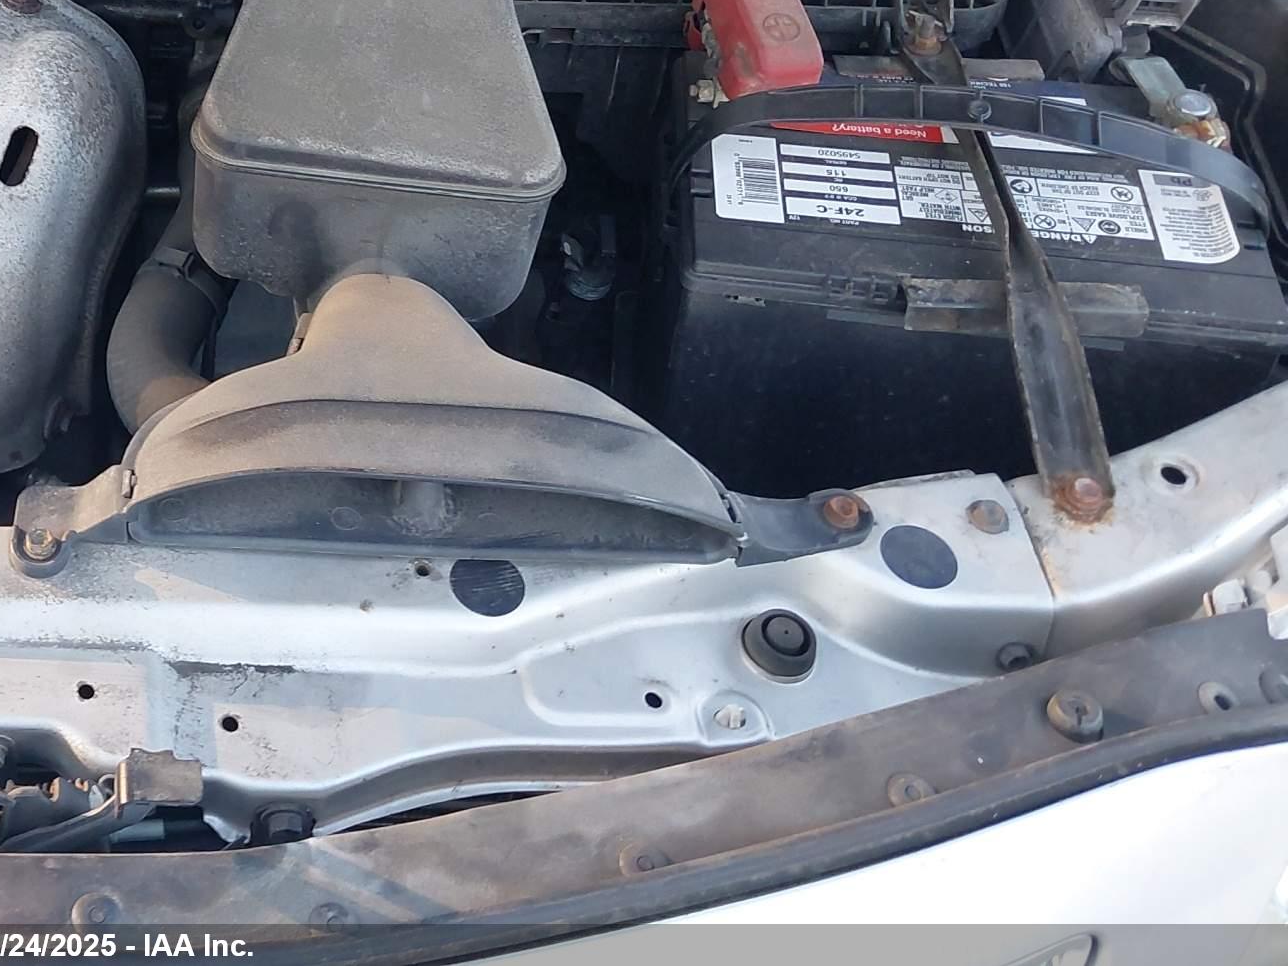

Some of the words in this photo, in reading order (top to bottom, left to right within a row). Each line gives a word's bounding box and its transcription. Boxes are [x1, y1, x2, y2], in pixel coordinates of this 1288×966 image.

[832, 123, 881, 135] battery?
[893, 127, 927, 138] Need
[817, 149, 861, 159] 5495020
[1171, 176, 1192, 186] Pb
[829, 185, 849, 193] 650
[816, 204, 865, 217] 24F-C
[961, 224, 992, 234] SON
[1031, 230, 1082, 242] DANGE
